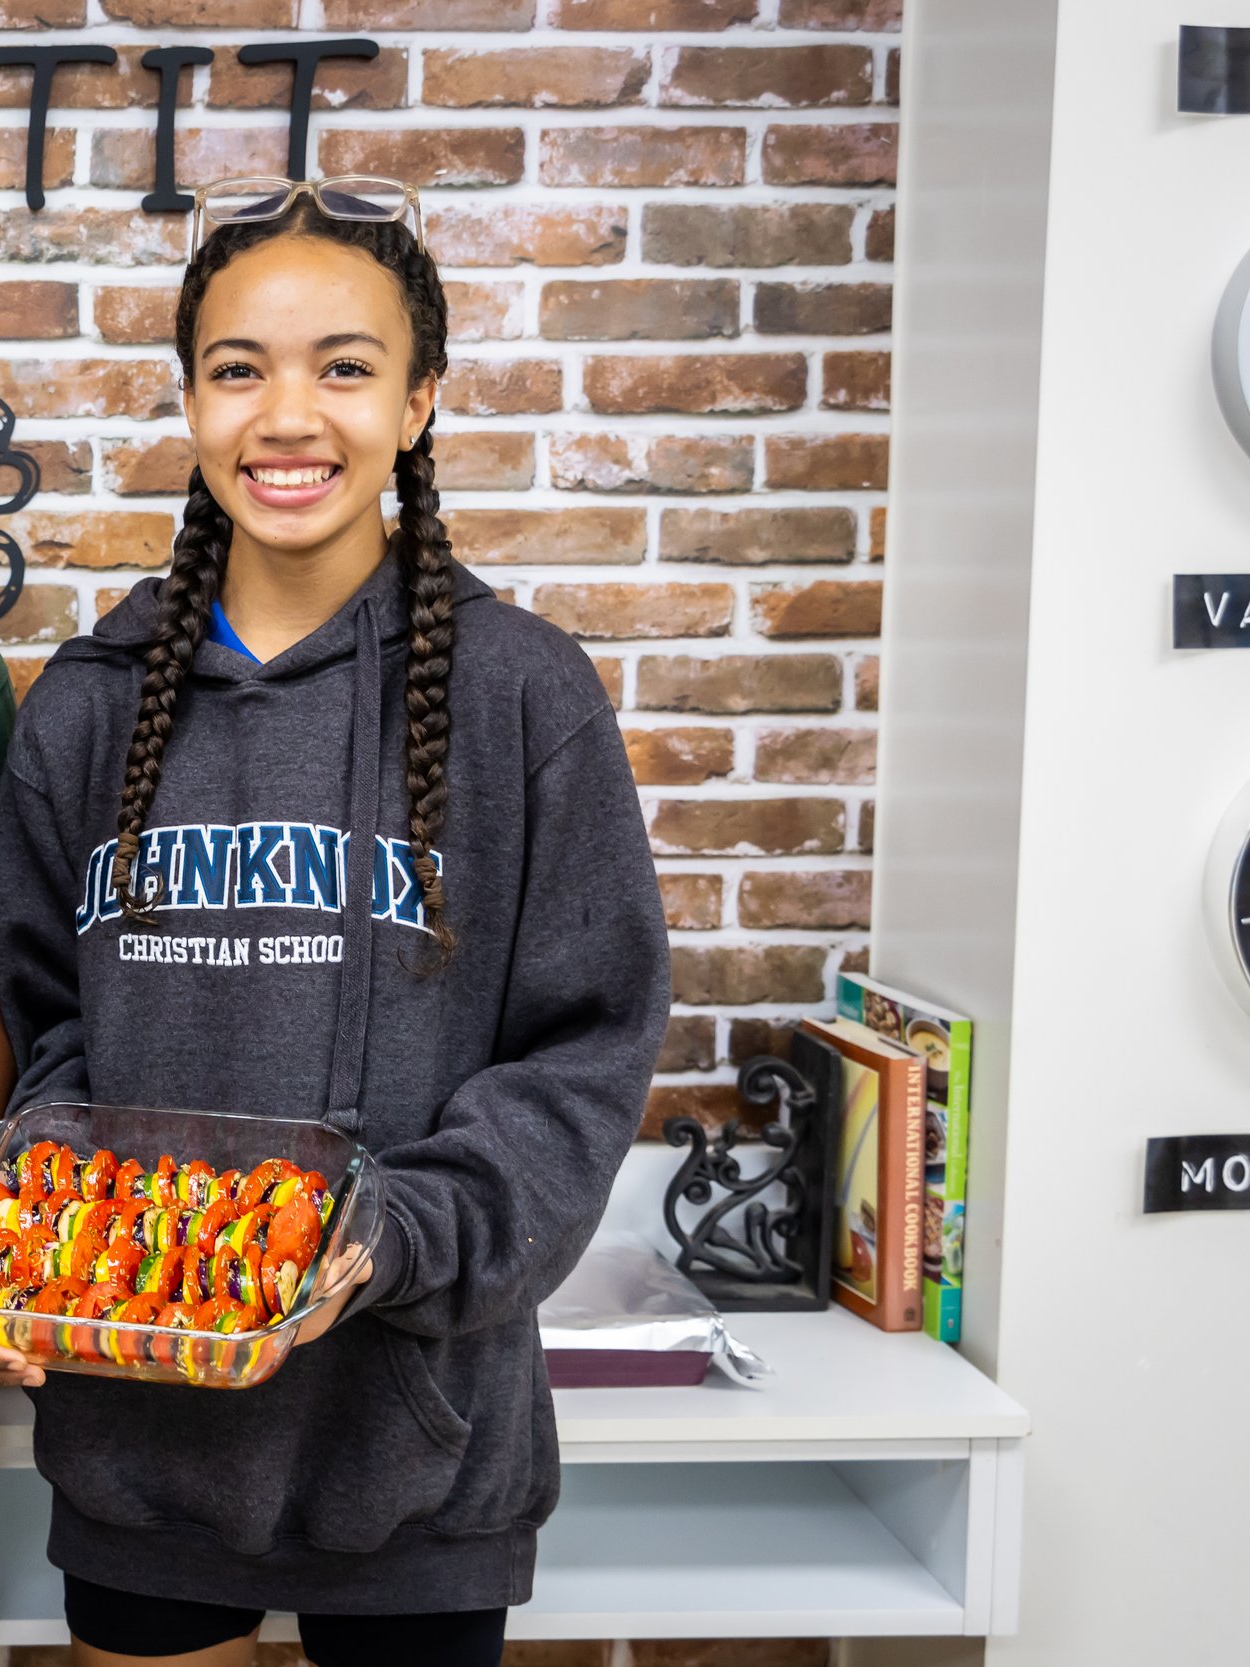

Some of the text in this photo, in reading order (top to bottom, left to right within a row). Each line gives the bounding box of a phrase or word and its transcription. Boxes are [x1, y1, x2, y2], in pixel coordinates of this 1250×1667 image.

[118, 933, 344, 967] CHRISTIAN SCHOO
[903, 1065, 921, 1291] INTERNATIONAL COOKBOOK
